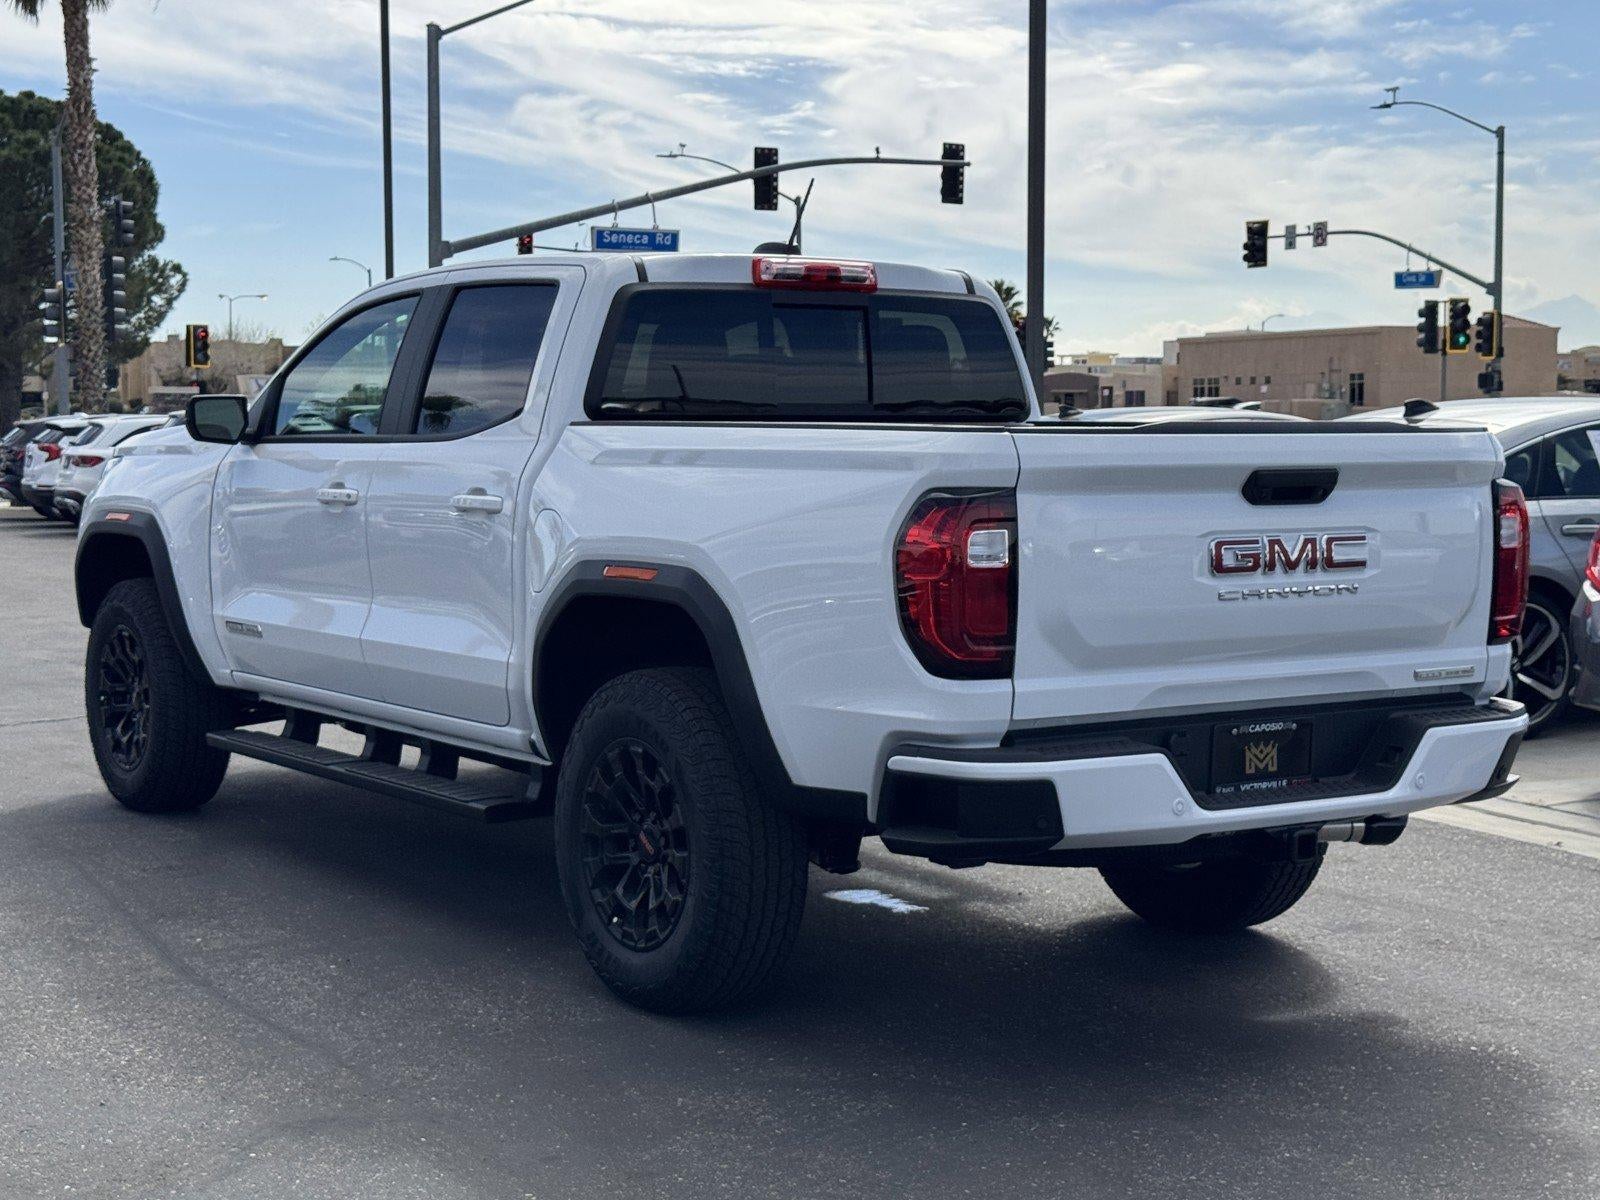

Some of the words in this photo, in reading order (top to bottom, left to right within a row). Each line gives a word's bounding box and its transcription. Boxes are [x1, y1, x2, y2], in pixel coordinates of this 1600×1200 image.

[602, 230, 649, 244] Seneca
[655, 232, 672, 245] Rd
[1210, 534, 1368, 576] GMC
[1217, 583, 1360, 601] CANYON
